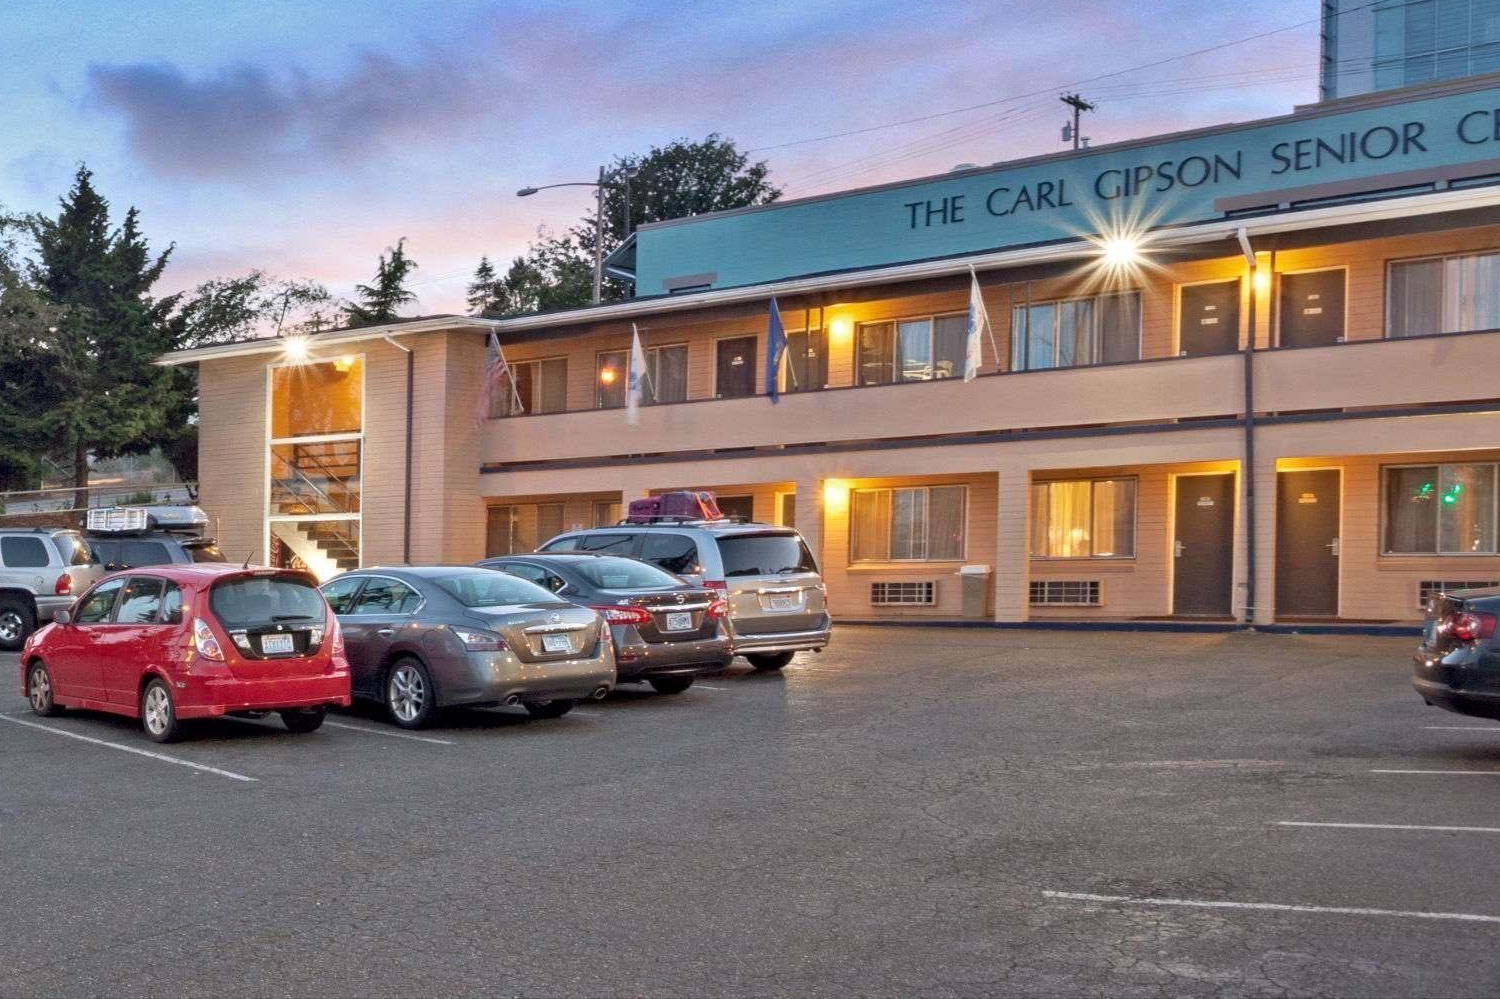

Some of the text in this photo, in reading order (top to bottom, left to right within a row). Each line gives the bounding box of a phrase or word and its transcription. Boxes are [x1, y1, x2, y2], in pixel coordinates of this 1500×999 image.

[904, 195, 966, 230] THE
[986, 178, 1074, 217] CARL
[1094, 149, 1243, 200] GIPSON
[1270, 121, 1427, 175] SENIOR
